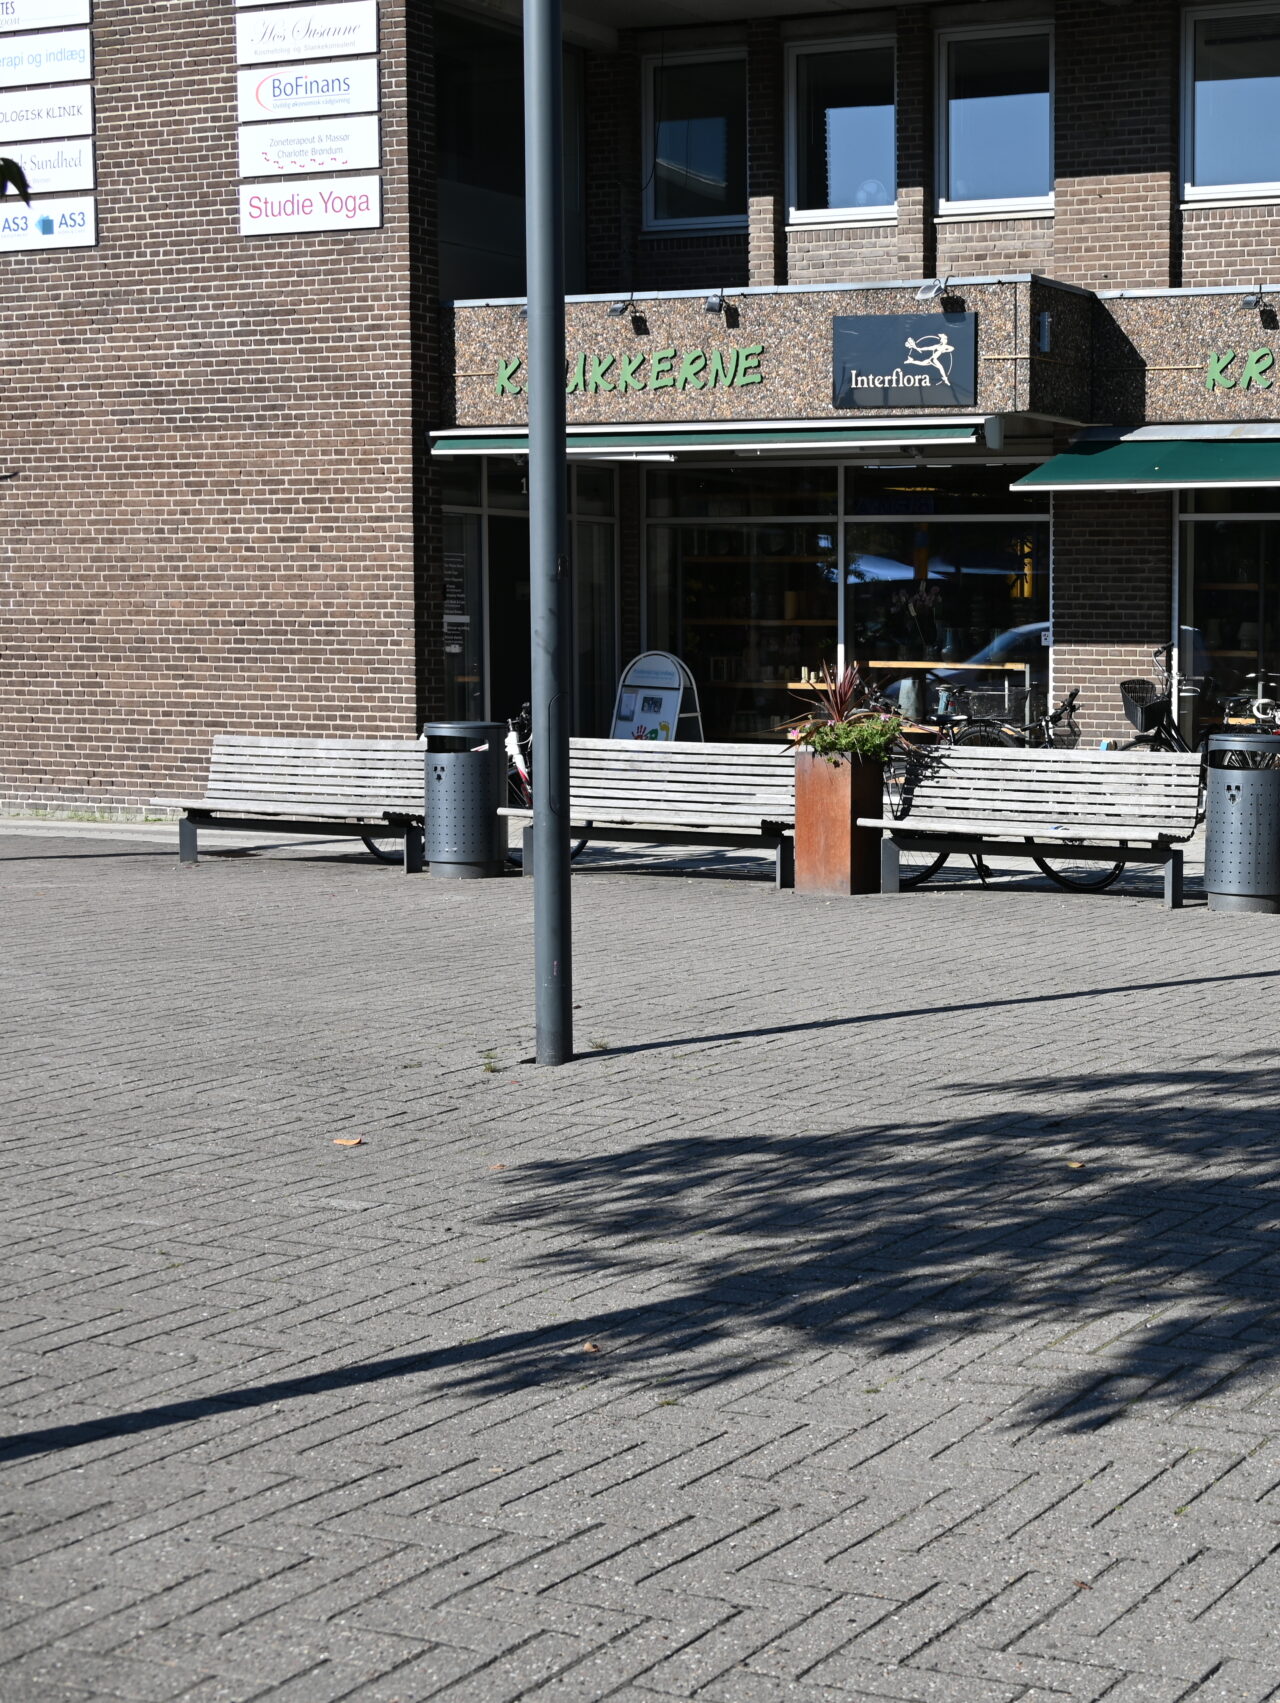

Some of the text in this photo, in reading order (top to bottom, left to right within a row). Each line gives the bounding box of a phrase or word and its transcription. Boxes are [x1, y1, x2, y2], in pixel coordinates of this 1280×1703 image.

[250, 14, 361, 44] Hos Susanne
[27, 53, 42, 68] og
[45, 48, 86, 63] indlæg
[272, 75, 351, 98] BoFinans
[46, 105, 84, 120] KLINIK
[269, 136, 316, 148] Zoneterapeut
[317, 134, 324, 144] &
[30, 149, 83, 171] Sundhed
[277, 146, 344, 159] Charlotte Brøndum
[249, 191, 371, 219] Studie Yoga
[2, 216, 29, 232] AS3
[58, 211, 86, 229] AS3
[495, 344, 765, 396] KUKKERNE
[850, 368, 932, 389] Interflora
